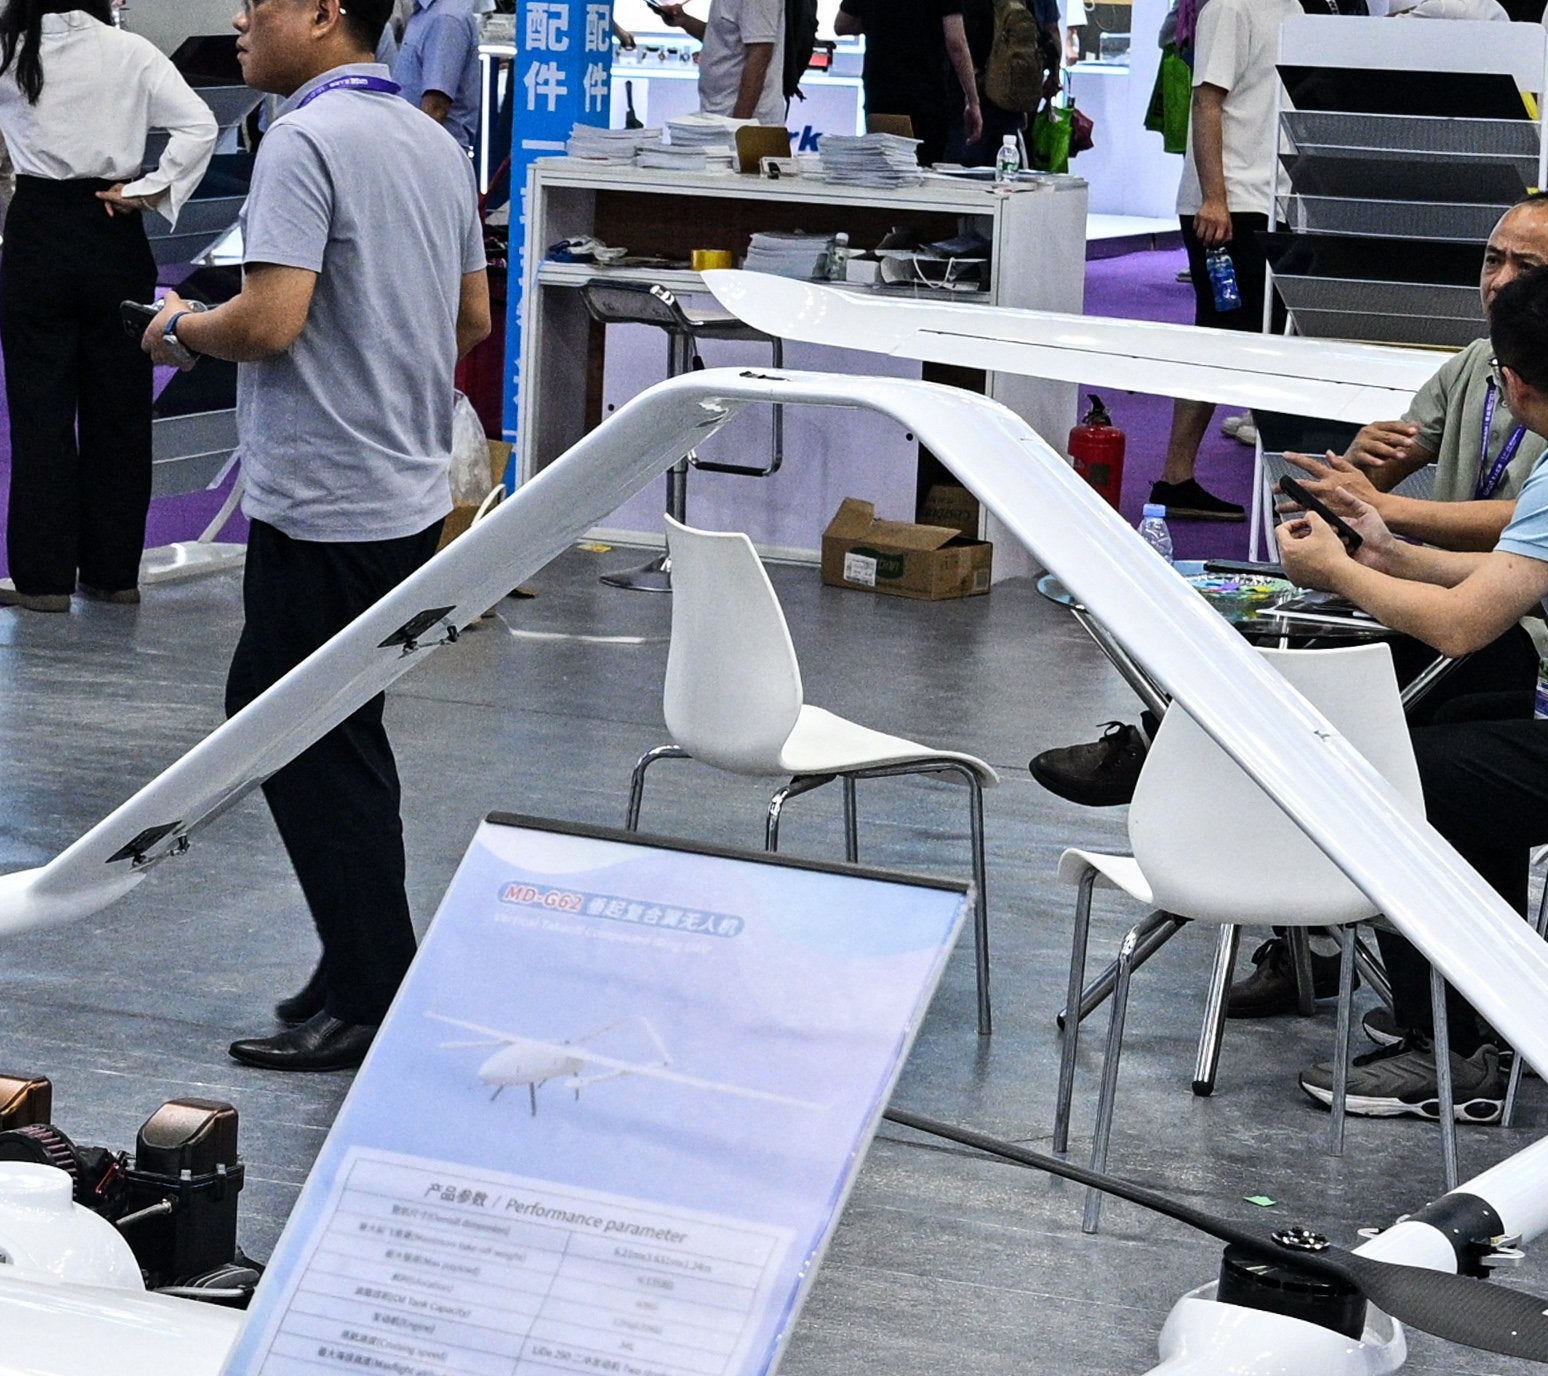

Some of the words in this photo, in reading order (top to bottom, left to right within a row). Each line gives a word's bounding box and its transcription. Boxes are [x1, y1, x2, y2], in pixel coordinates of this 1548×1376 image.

[504, 885, 583, 912] MD-G62
[423, 1181, 490, 1208] 产品参数
[503, 1196, 606, 1229] Performance
[602, 1216, 689, 1247] parameter
